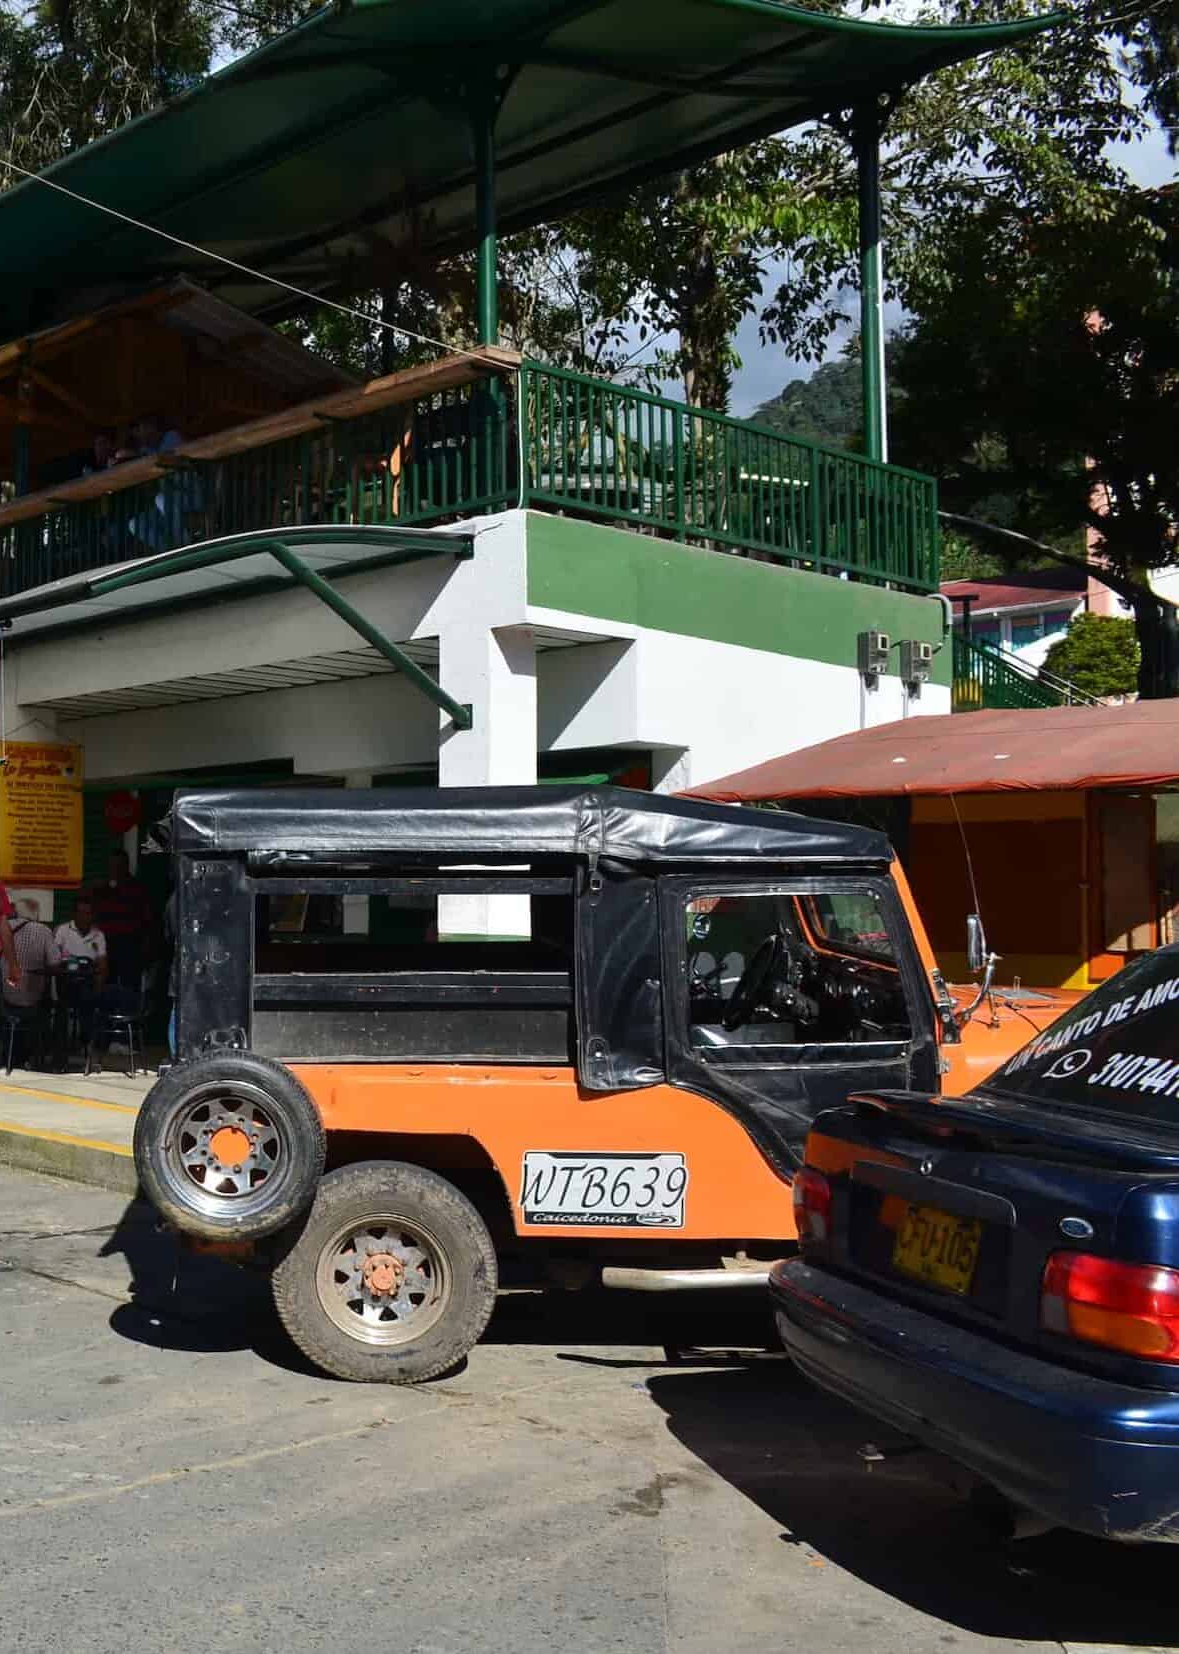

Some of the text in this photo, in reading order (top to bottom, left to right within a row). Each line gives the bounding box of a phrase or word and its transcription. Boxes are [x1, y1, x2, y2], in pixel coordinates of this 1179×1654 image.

[1033, 1010, 1103, 1060] CANTO
[1100, 994, 1137, 1028] DE
[520, 1163, 688, 1209] WTB639
[532, 1212, 632, 1225] Caicedonia
